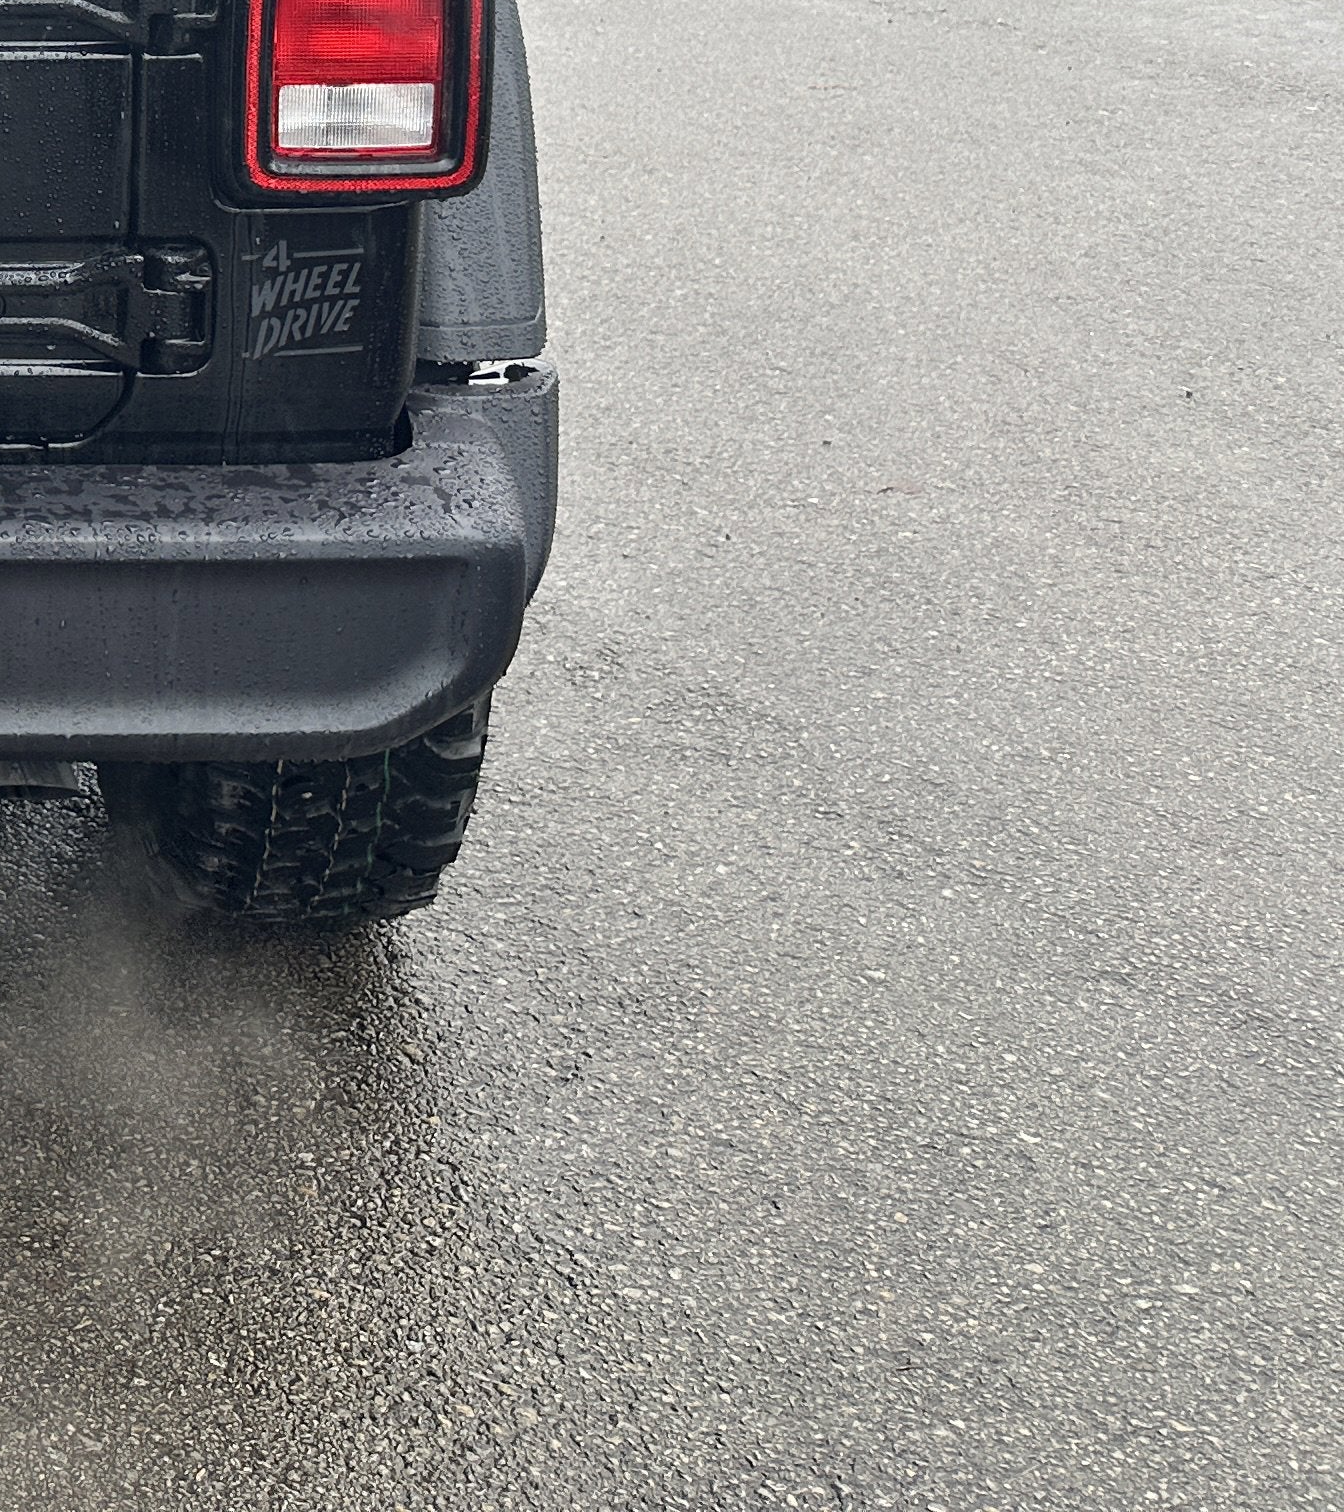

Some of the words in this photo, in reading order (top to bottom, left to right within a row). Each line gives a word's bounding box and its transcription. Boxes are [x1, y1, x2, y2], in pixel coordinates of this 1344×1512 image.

[261, 240, 291, 272] 4
[252, 262, 362, 317] WHEEL
[253, 299, 360, 360] DRIVE
